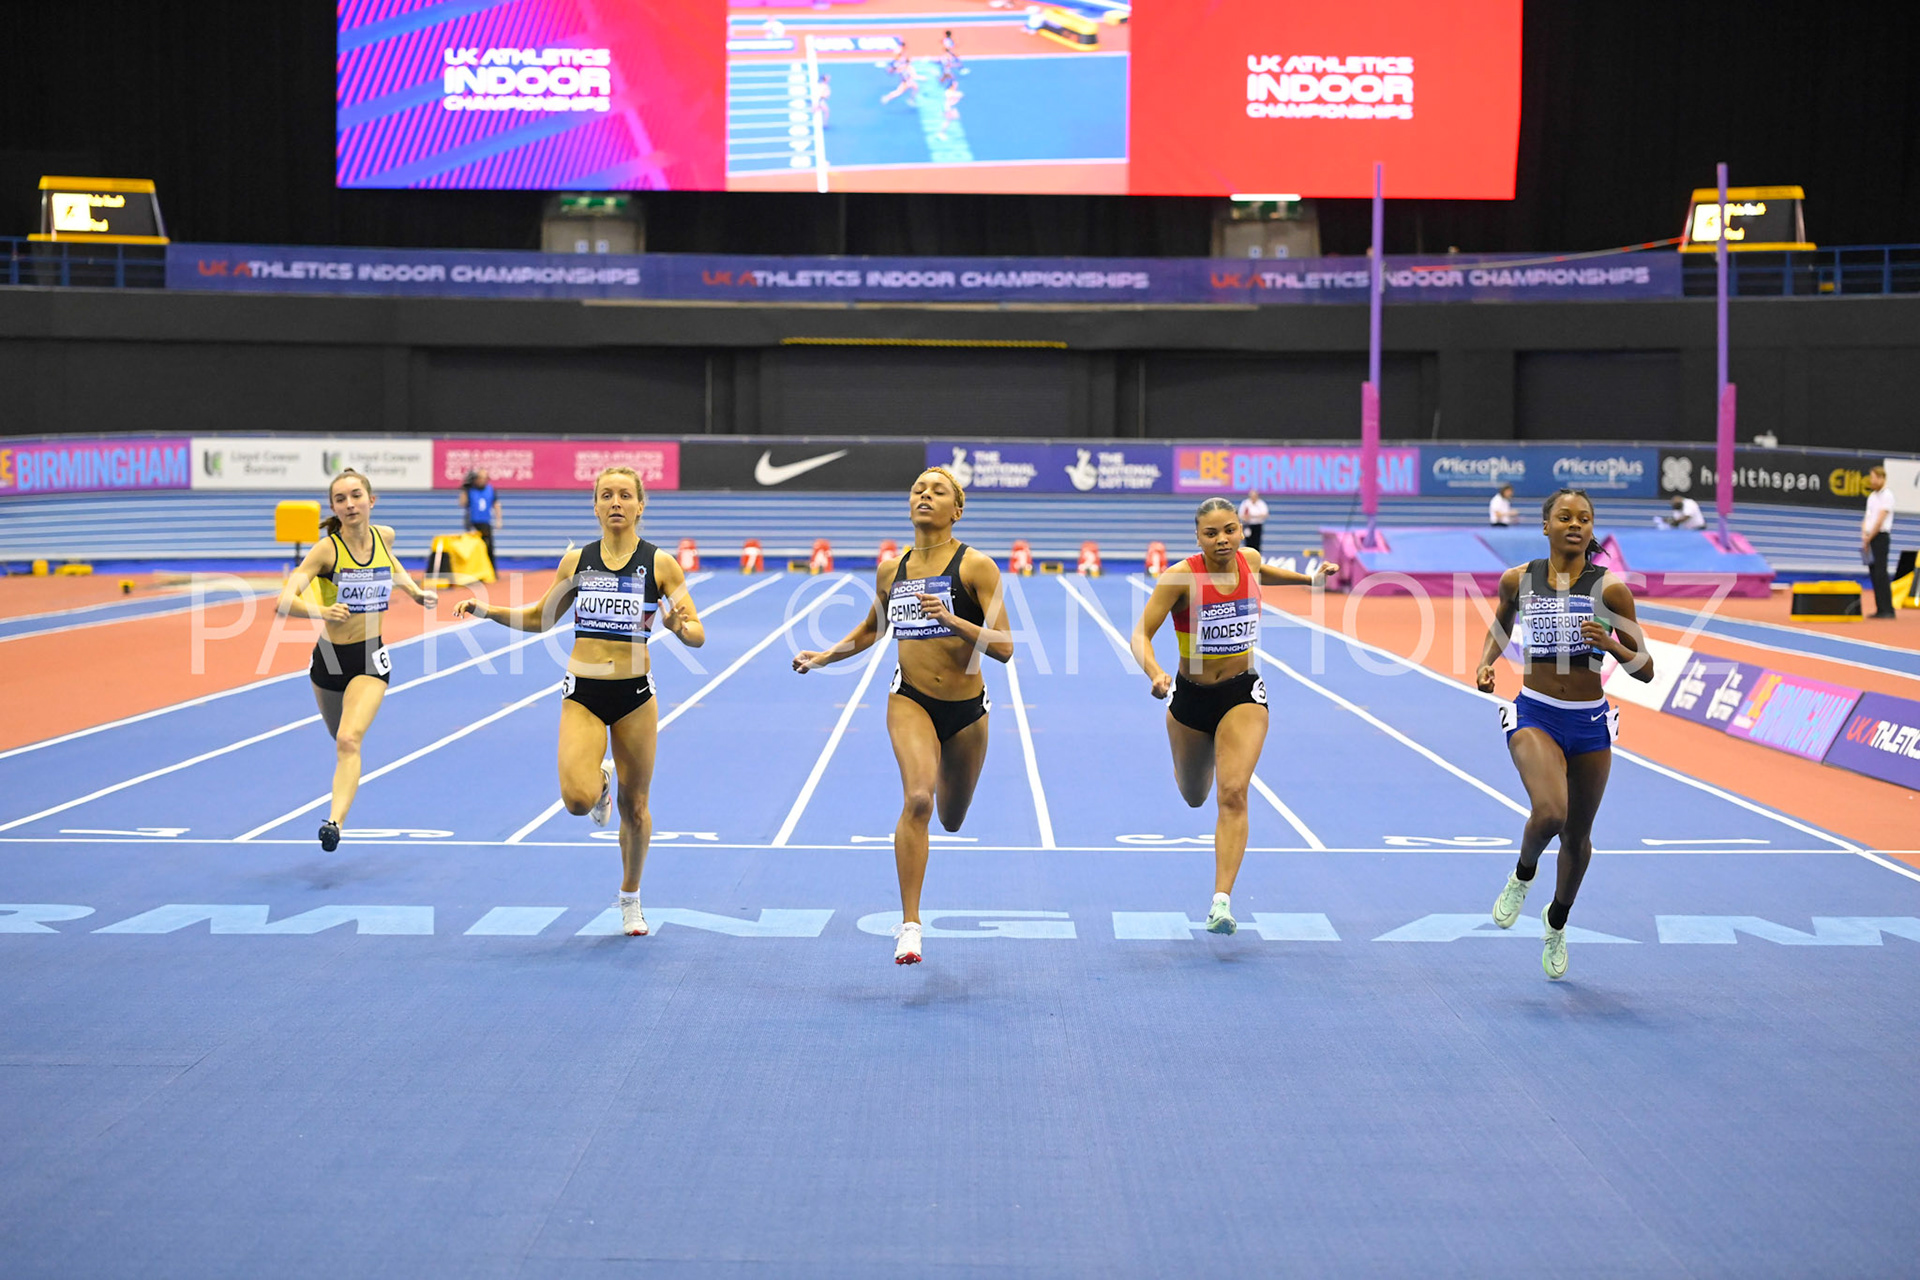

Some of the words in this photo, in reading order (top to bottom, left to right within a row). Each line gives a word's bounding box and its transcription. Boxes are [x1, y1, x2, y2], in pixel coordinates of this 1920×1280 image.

[1283, 55, 1414, 74] ATHLETICS
[443, 66, 611, 95] INDOOR
[1246, 73, 1414, 103] INDOOR
[198, 260, 228, 277] UK
[233, 261, 354, 280] ATHLETICS
[358, 263, 446, 282] INDOOR
[450, 265, 641, 286] CHAMPIONSHIPS
[702, 270, 732, 286] UK
[737, 270, 862, 287] ATHLETICS
[866, 270, 956, 288] INDOOR
[960, 271, 1150, 289] CHAMPIONSHIPS
[1210, 272, 1241, 289] UK
[1246, 271, 1370, 289] ATHLETICS
[1384, 270, 1463, 287] NDOOR
[1468, 266, 1650, 287] CHAMPIONSHIPS
[16, 447, 189, 490] BIRMINGHAM
[1201, 451, 1230, 480] BE
[341, 586, 388, 600] CAYGILL
[579, 597, 640, 616] KUYPERS
[891, 599, 951, 622] PEMBEN
[1200, 607, 1236, 617] INDOOR
[1525, 602, 1565, 610] INDOOR
[581, 619, 638, 631] BIRMINGHAM
[1200, 620, 1257, 640] MODESTE
[1532, 631, 1586, 644] GOODISO
[1529, 644, 1591, 654] BIRMINGHAM
[379, 652, 389, 669] 6
[1257, 681, 1266, 700] 3
[1499, 706, 1510, 729] 2
[1846, 715, 1872, 743] UK
[1860, 719, 1920, 760] ATHLETIC
